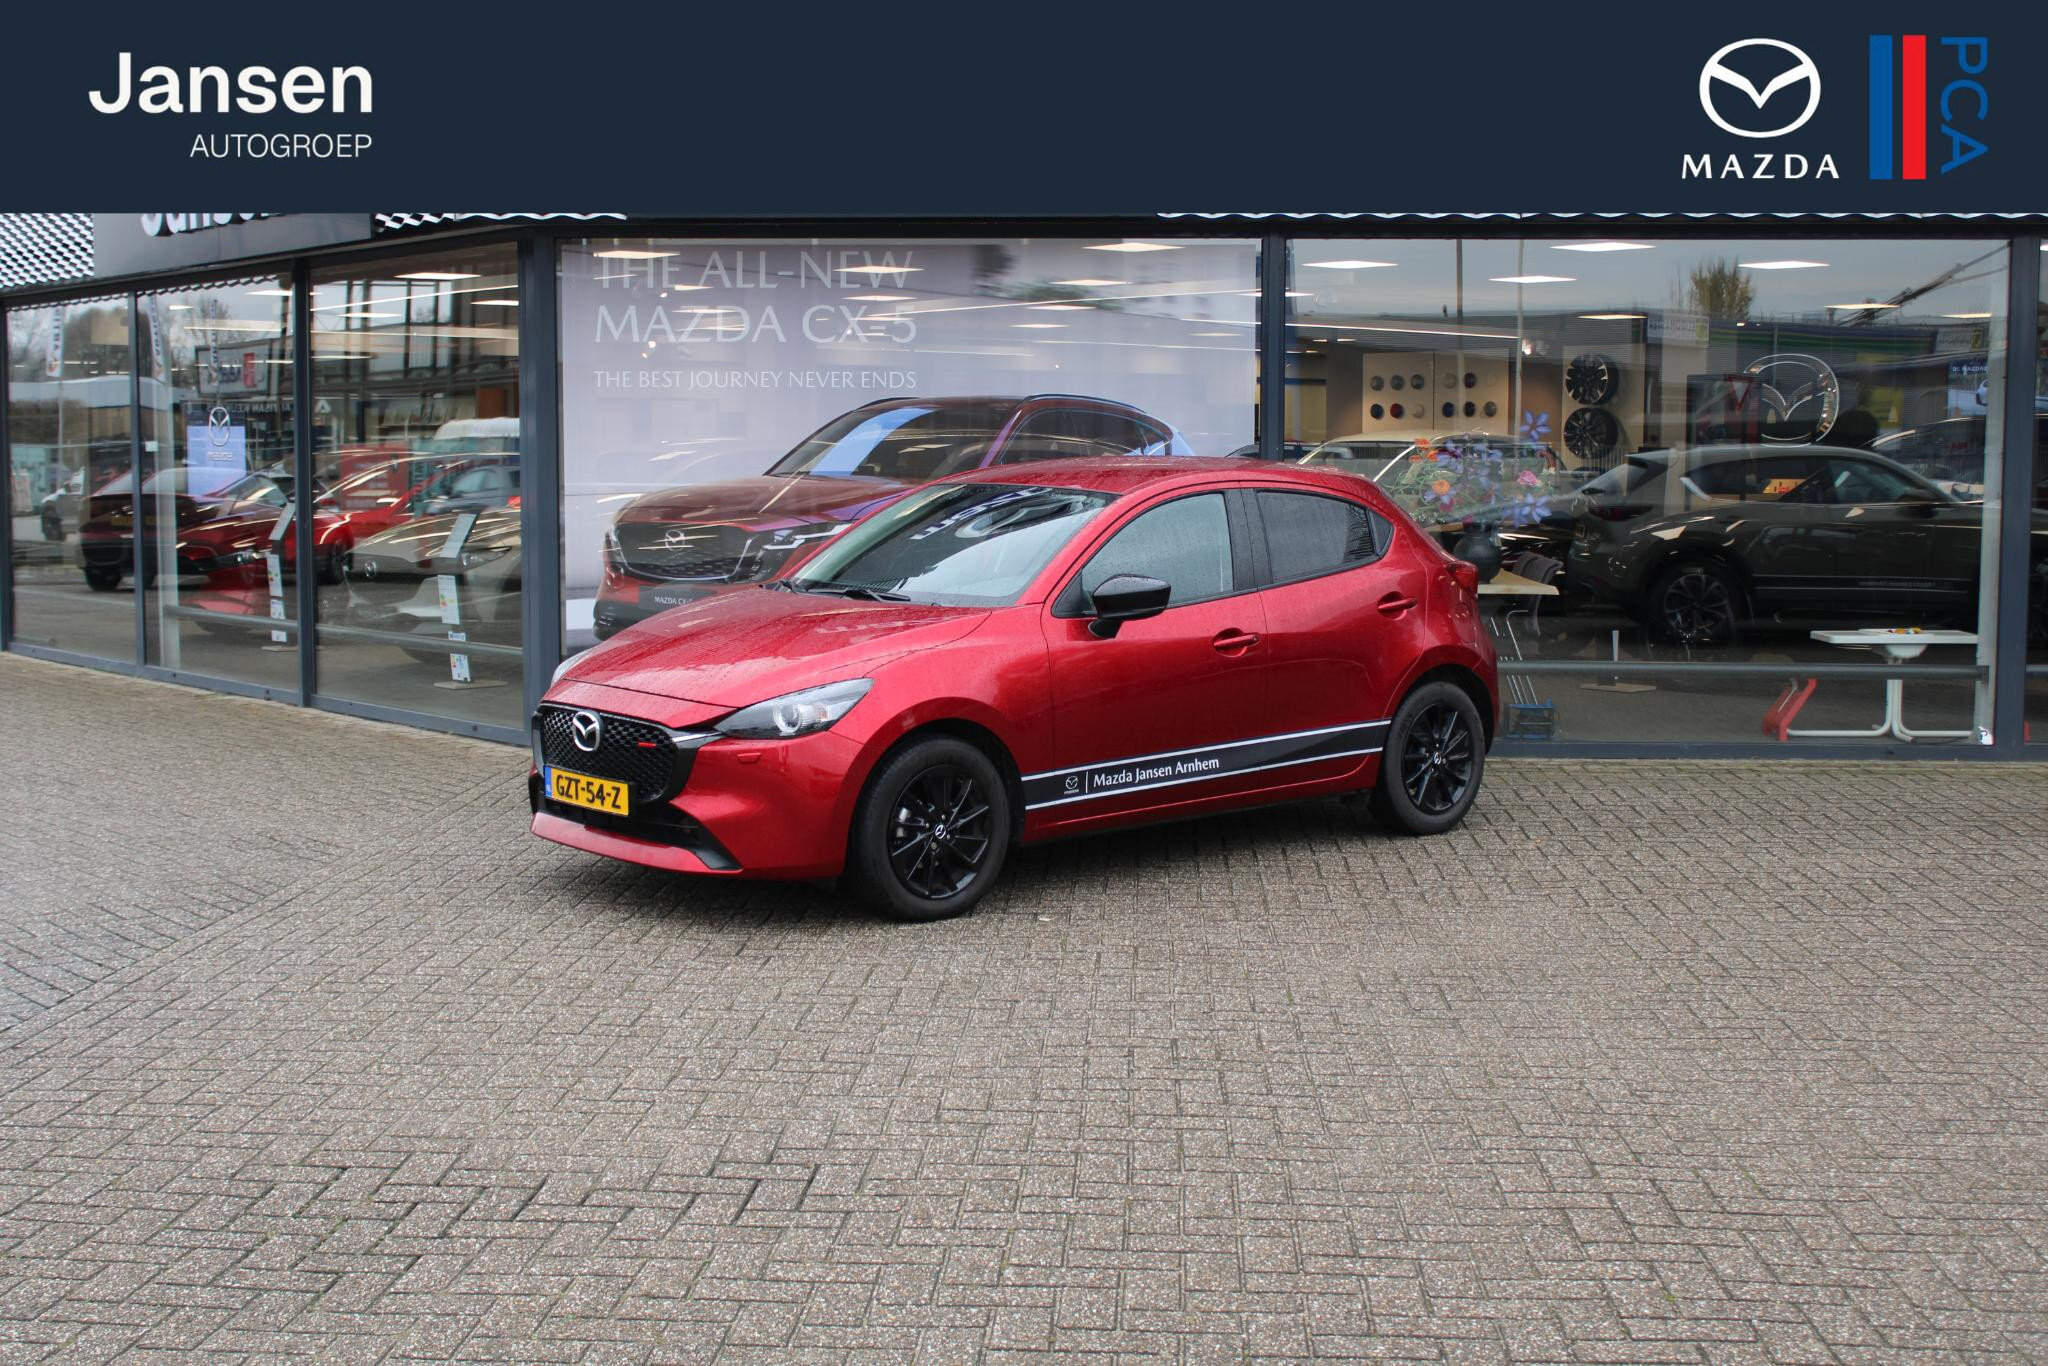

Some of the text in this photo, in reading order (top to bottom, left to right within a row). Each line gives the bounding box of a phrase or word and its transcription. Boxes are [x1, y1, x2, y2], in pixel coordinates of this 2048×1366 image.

[595, 250, 913, 289] THE ALL-NEW
[594, 304, 917, 343] MAZDA CX-5
[593, 370, 917, 391] THE BEST JOURNEY NEVER ENDS
[654, 595, 677, 605] MAZDA
[1093, 757, 1220, 788] Mazda Jansen Arnhem
[556, 774, 622, 810] GZT-54-Z
